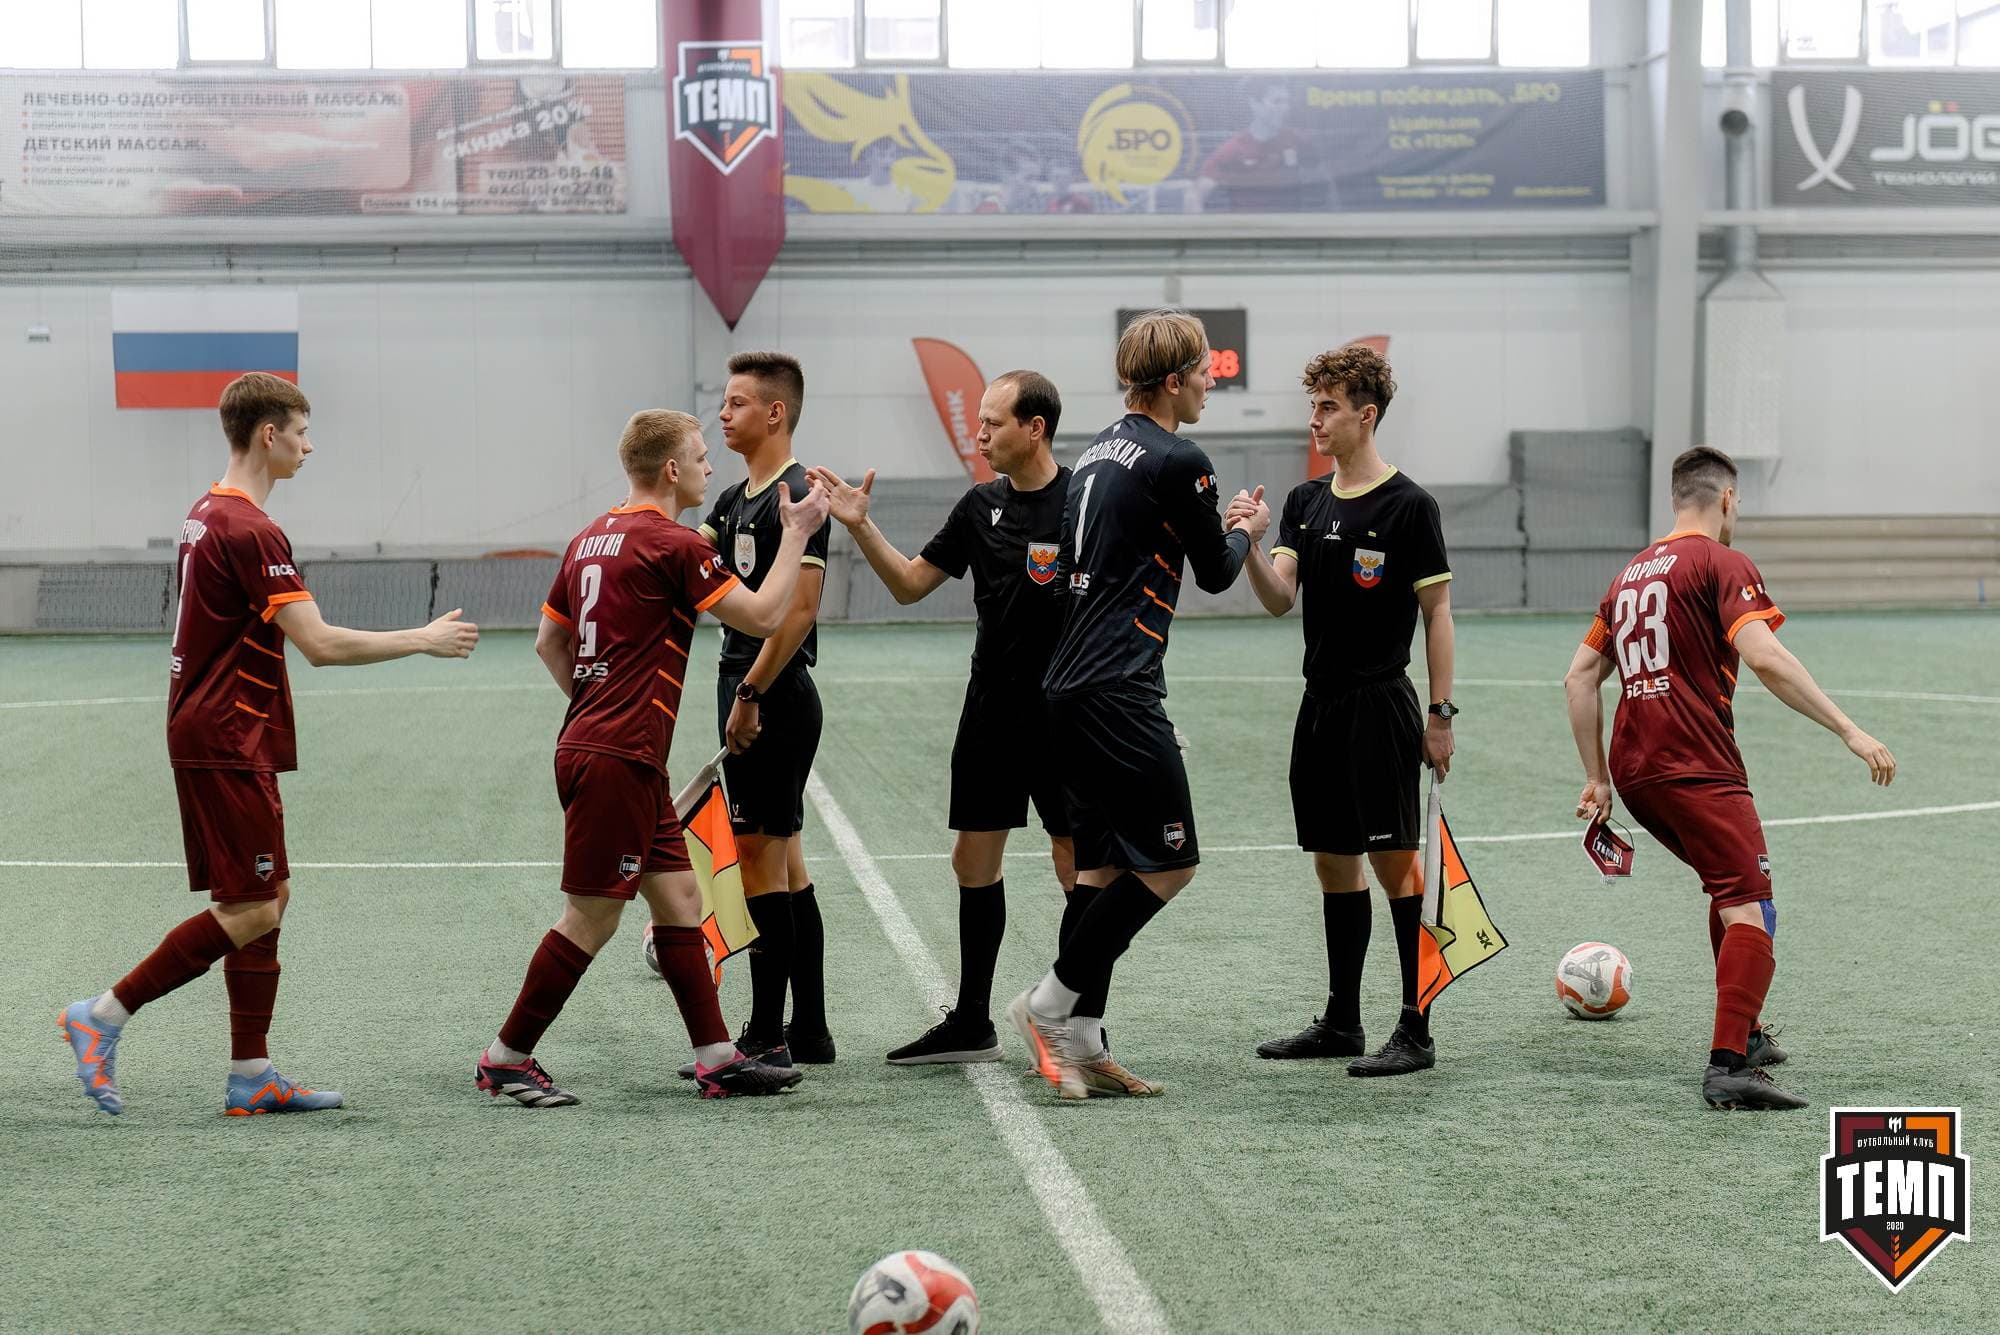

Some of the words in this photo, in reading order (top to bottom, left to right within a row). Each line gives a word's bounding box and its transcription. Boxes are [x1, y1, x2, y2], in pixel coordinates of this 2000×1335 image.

[535, 96, 592, 133] 20%
[684, 78, 767, 125] ТЕМП
[23, 137, 112, 152] ДЕТСКИЙ
[1075, 473, 1096, 565] 1
[578, 564, 602, 657] 2
[1615, 580, 1670, 681] 23
[1596, 840, 1620, 864] ТЕМП
